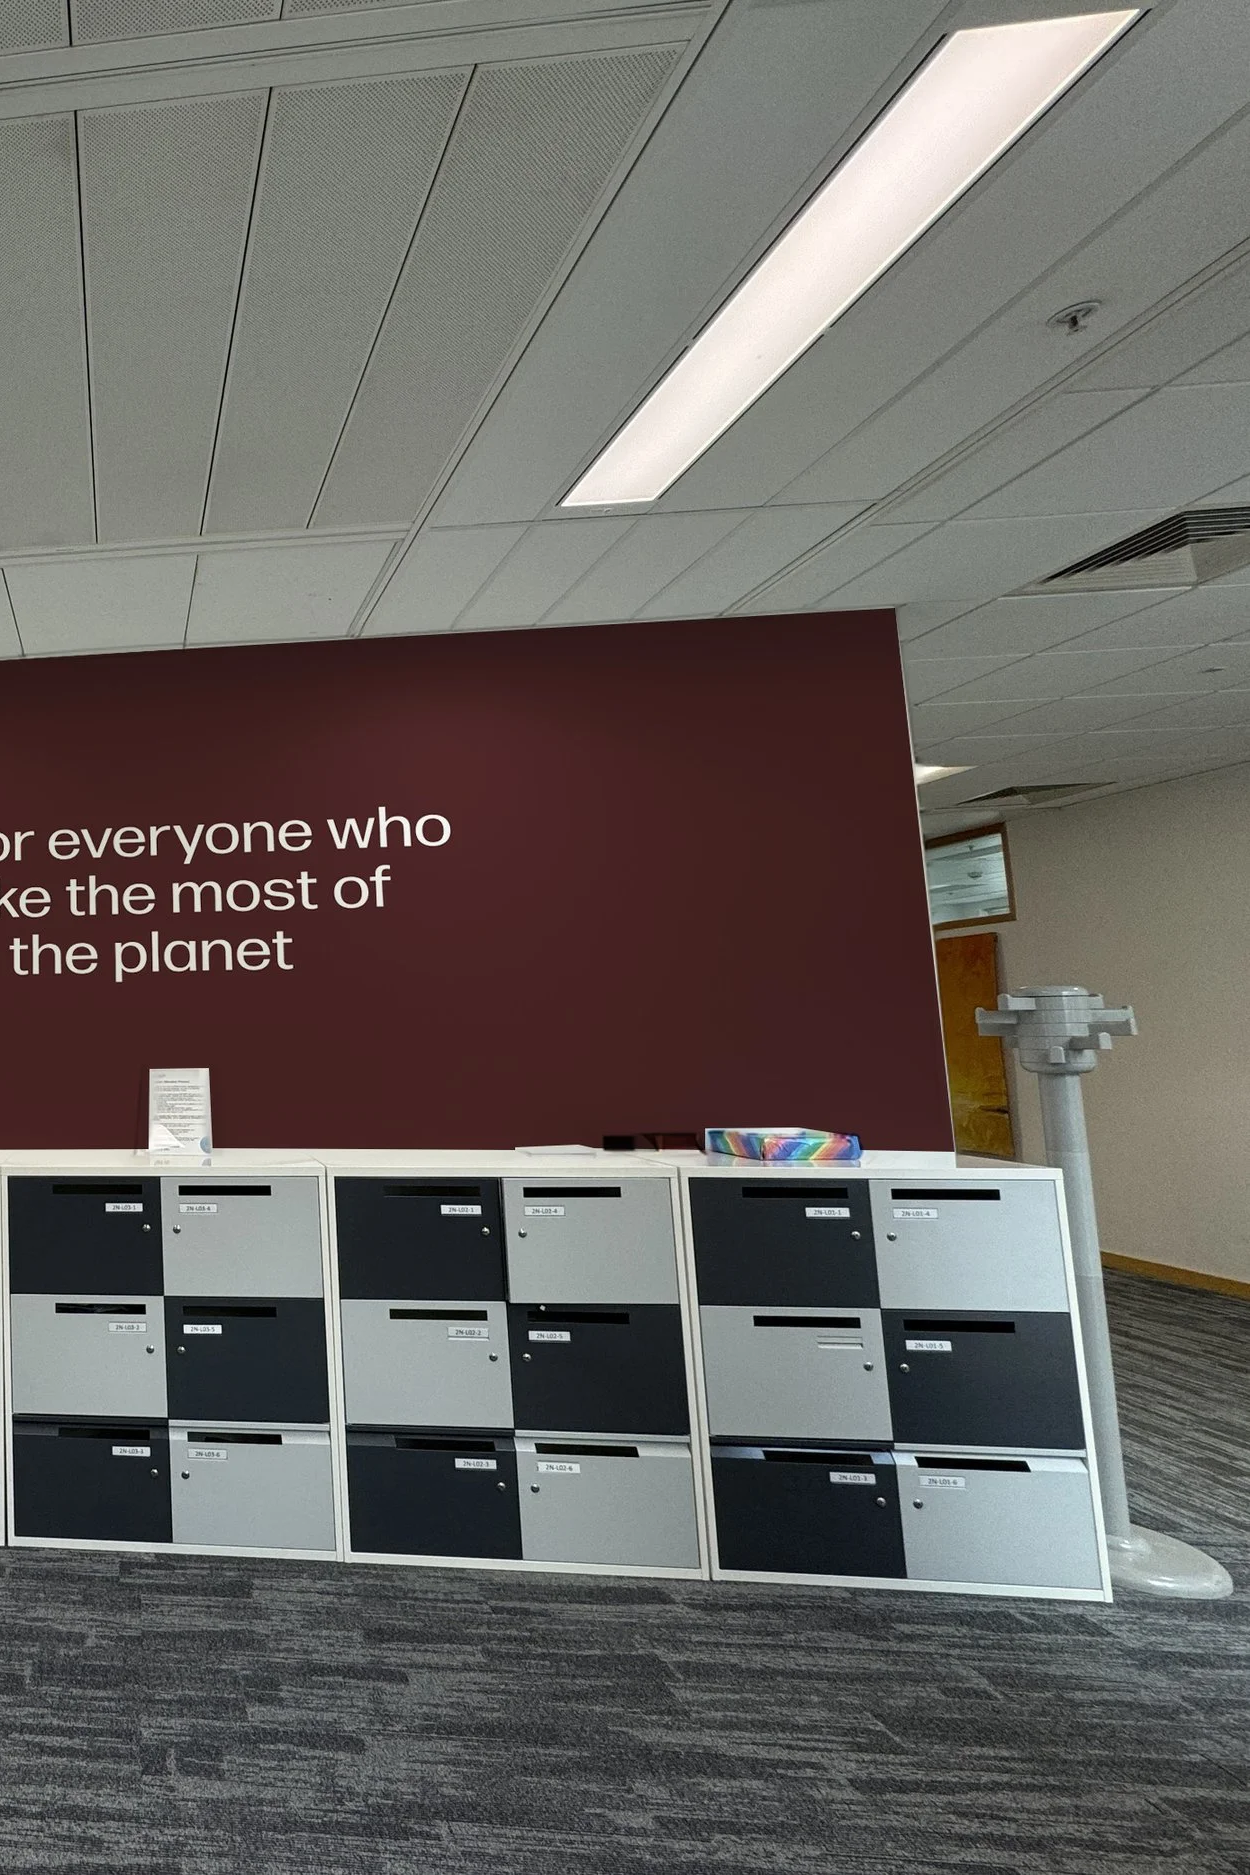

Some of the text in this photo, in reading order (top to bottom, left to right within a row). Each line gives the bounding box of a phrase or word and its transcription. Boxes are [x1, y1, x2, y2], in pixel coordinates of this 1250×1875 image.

[48, 819, 313, 865] everyone
[326, 806, 452, 850] who
[65, 874, 156, 917] the
[172, 870, 319, 914] most
[333, 864, 392, 909] of
[8, 933, 99, 976] the
[114, 930, 294, 983] planet
